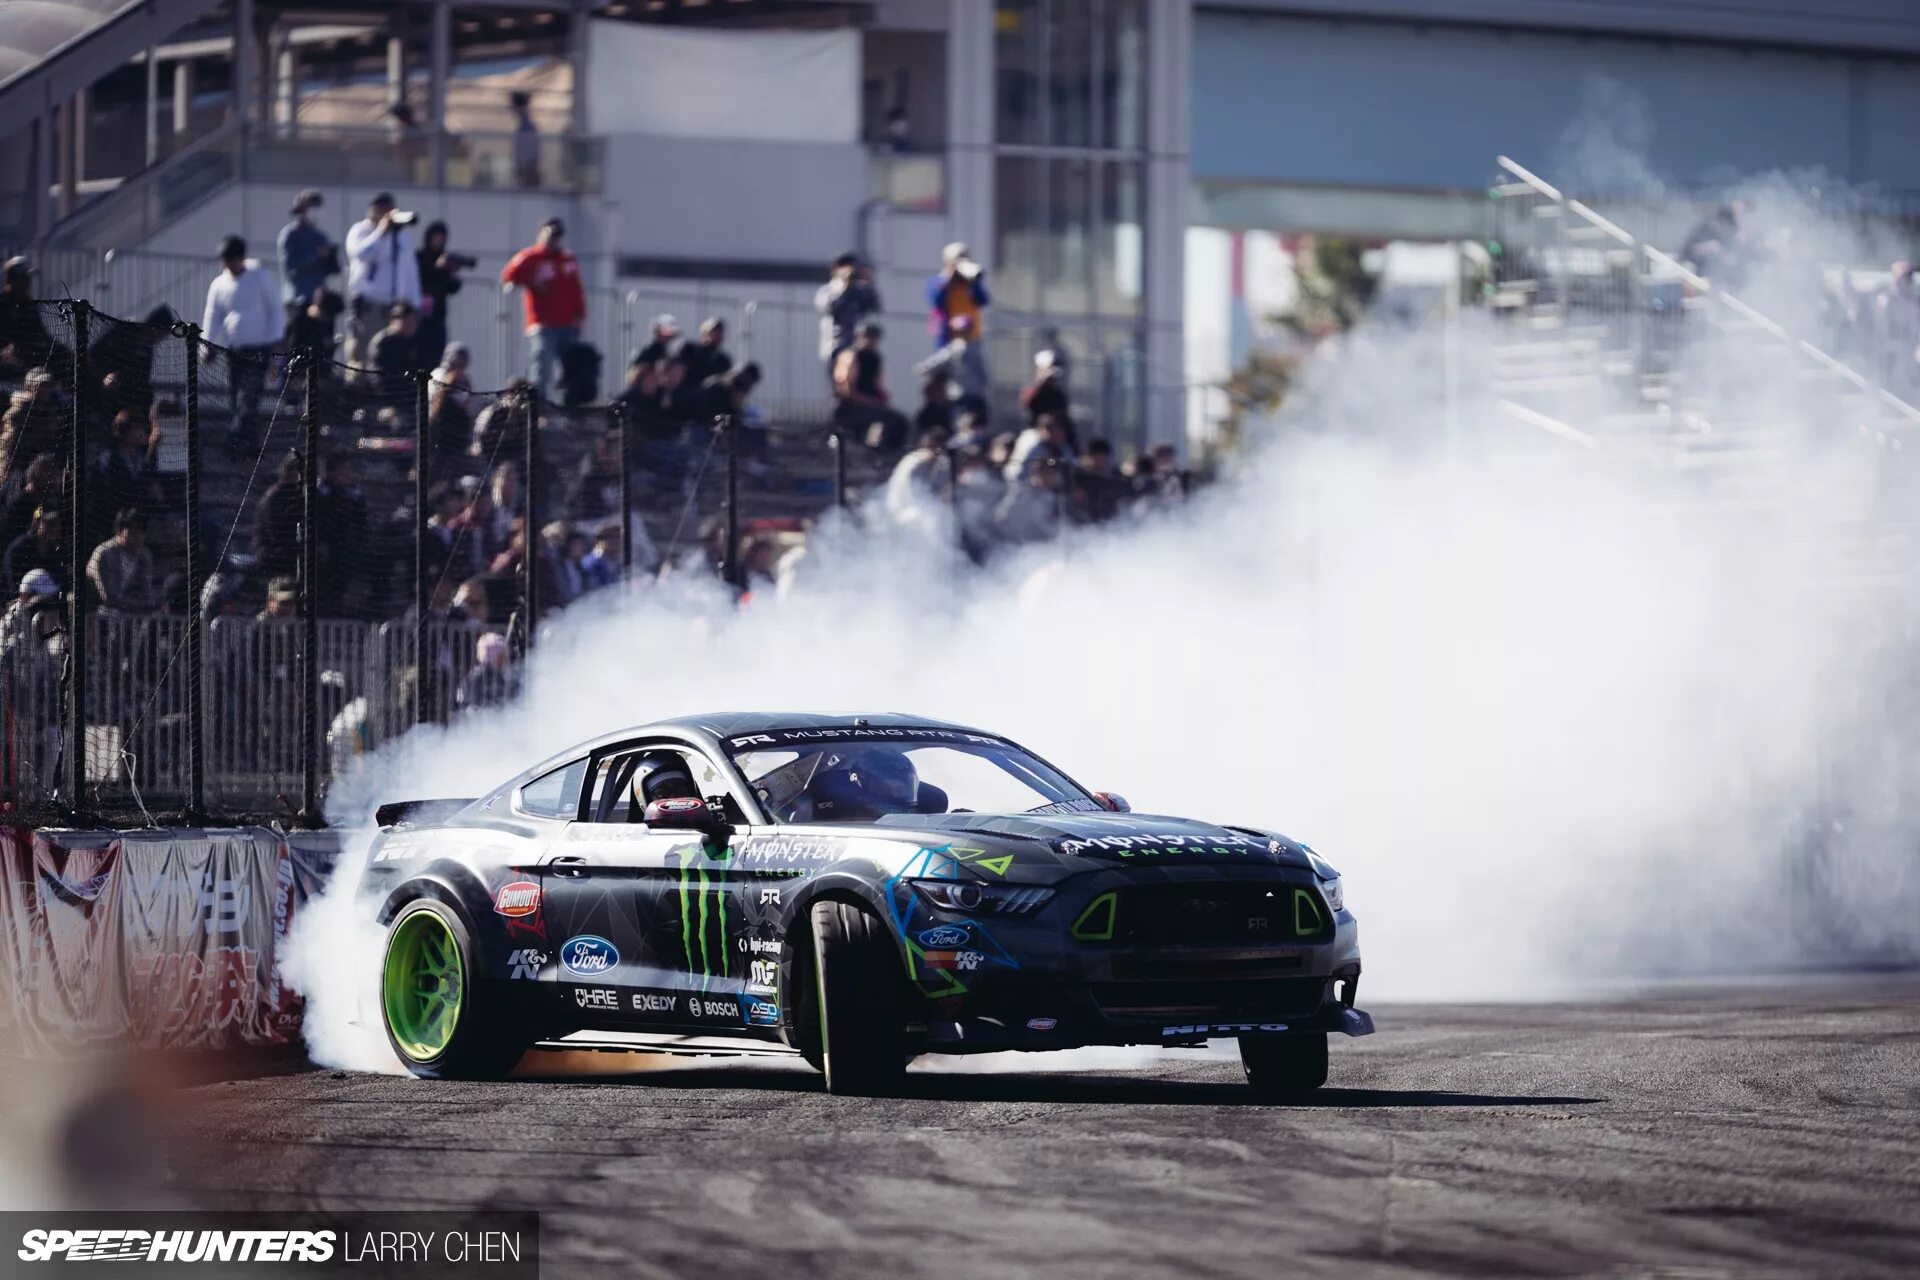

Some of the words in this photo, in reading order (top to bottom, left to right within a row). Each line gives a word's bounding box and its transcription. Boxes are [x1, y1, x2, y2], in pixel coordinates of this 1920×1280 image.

[784, 729, 903, 739] MUSTANG
[908, 729, 956, 739] RTR
[742, 837, 840, 863] MONSTER
[1061, 834, 1266, 850] MONSTER
[1118, 847, 1248, 858] ENERGY
[755, 867, 817, 878] ENERGY
[499, 889, 538, 908] GUMOUT
[929, 929, 960, 945] Ford
[572, 941, 608, 969] Ford
[584, 989, 619, 1005] HRE
[632, 994, 677, 1011] EXEDY
[704, 1001, 739, 1017] BOSCH
[750, 1003, 777, 1016] ASD
[1162, 1023, 1289, 1036] NITTO
